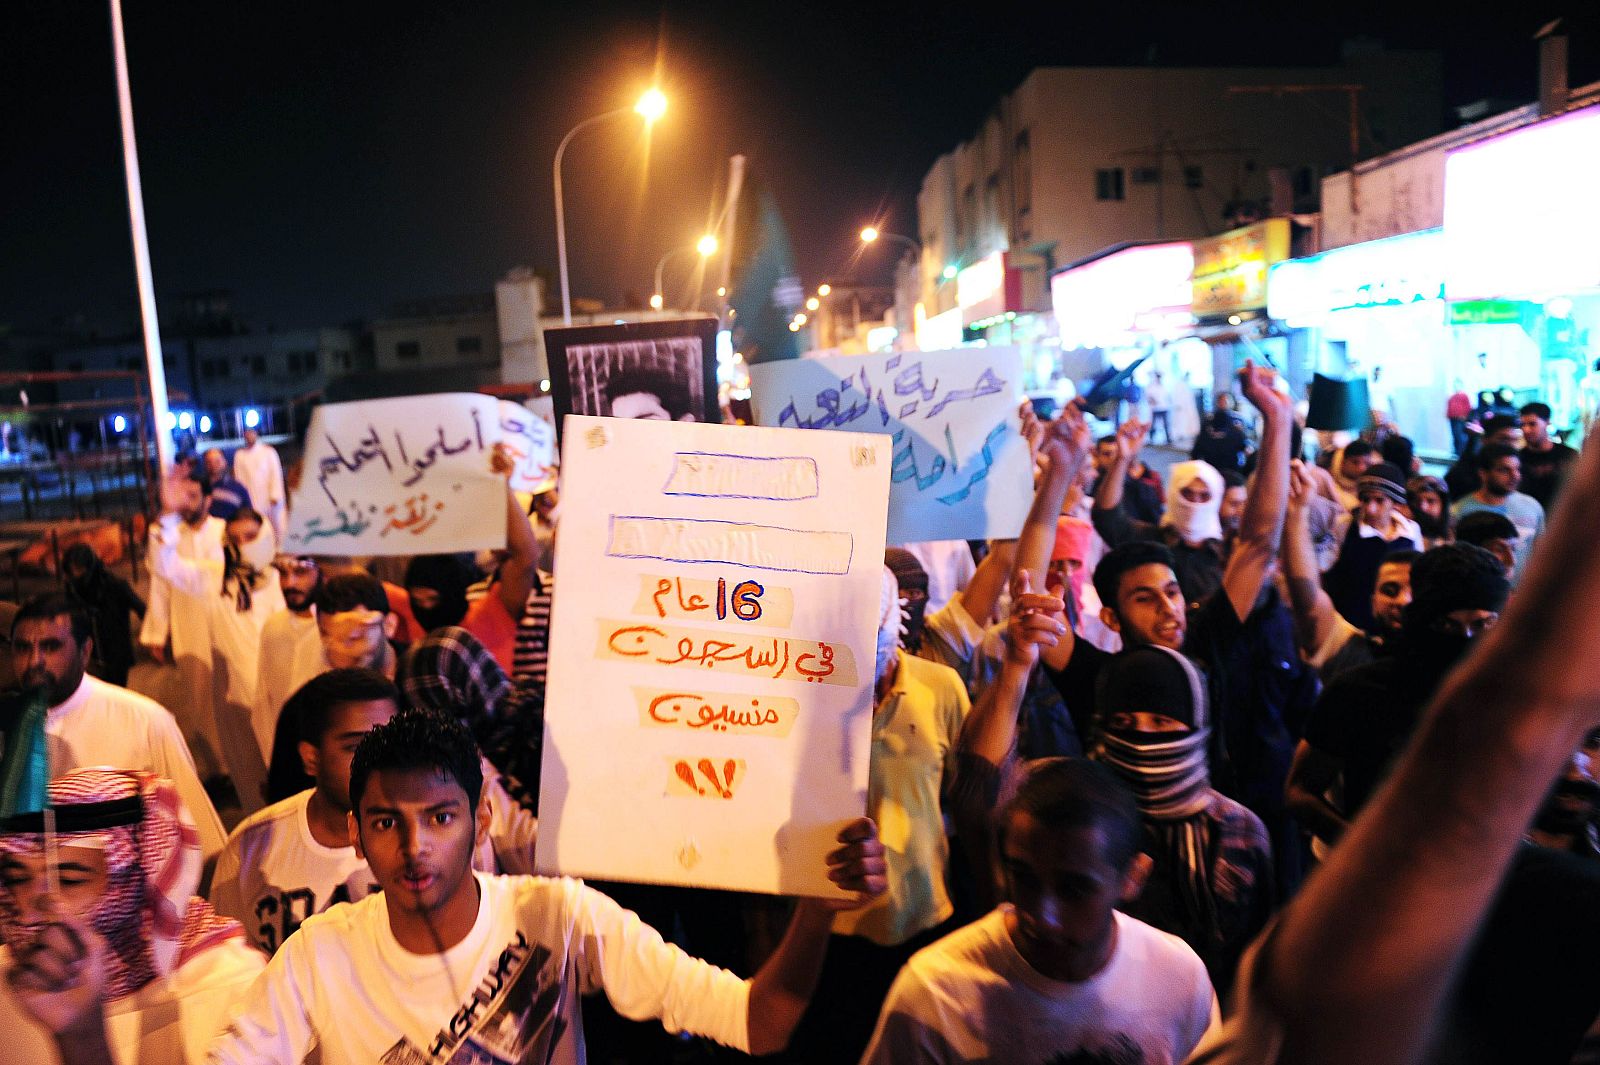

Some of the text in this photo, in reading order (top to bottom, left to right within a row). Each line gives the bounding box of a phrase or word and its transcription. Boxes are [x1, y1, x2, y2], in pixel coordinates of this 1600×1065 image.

[885, 354, 1007, 419] حرية
[652, 576, 766, 621] 16 عام
[607, 625, 836, 684] في السجون
[648, 692, 780, 732] منسيون
[427, 929, 529, 1063] HIGHWAY
